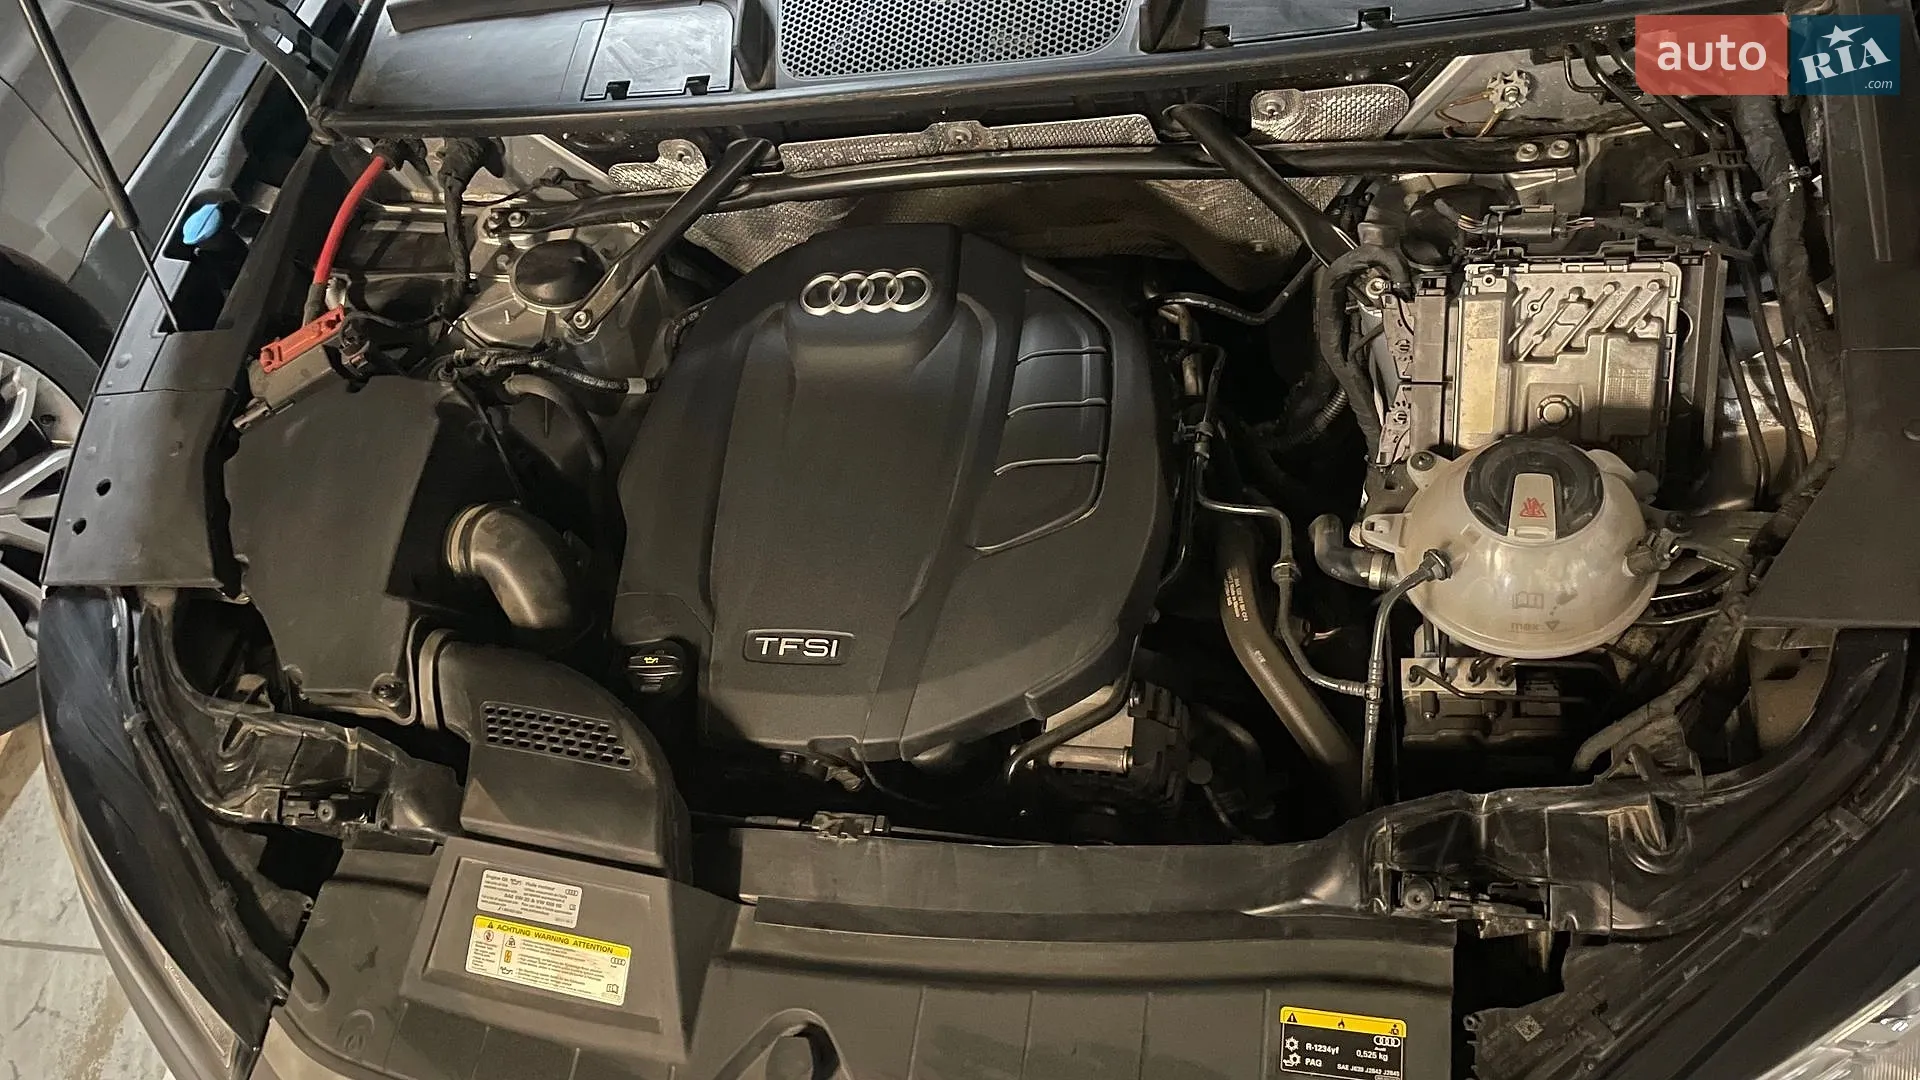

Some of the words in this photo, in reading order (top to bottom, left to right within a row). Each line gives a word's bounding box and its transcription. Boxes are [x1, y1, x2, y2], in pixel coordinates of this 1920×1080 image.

[1511, 622, 1539, 632] max
[754, 636, 838, 658] TFSI
[496, 923, 531, 937] ACHTUNG
[534, 931, 570, 945] WARNING
[572, 939, 614, 954] ATTENTION
[1305, 1042, 1339, 1055] R-1234yf
[1378, 1054, 1388, 1062] kg
[1305, 1058, 1322, 1067] PAG
